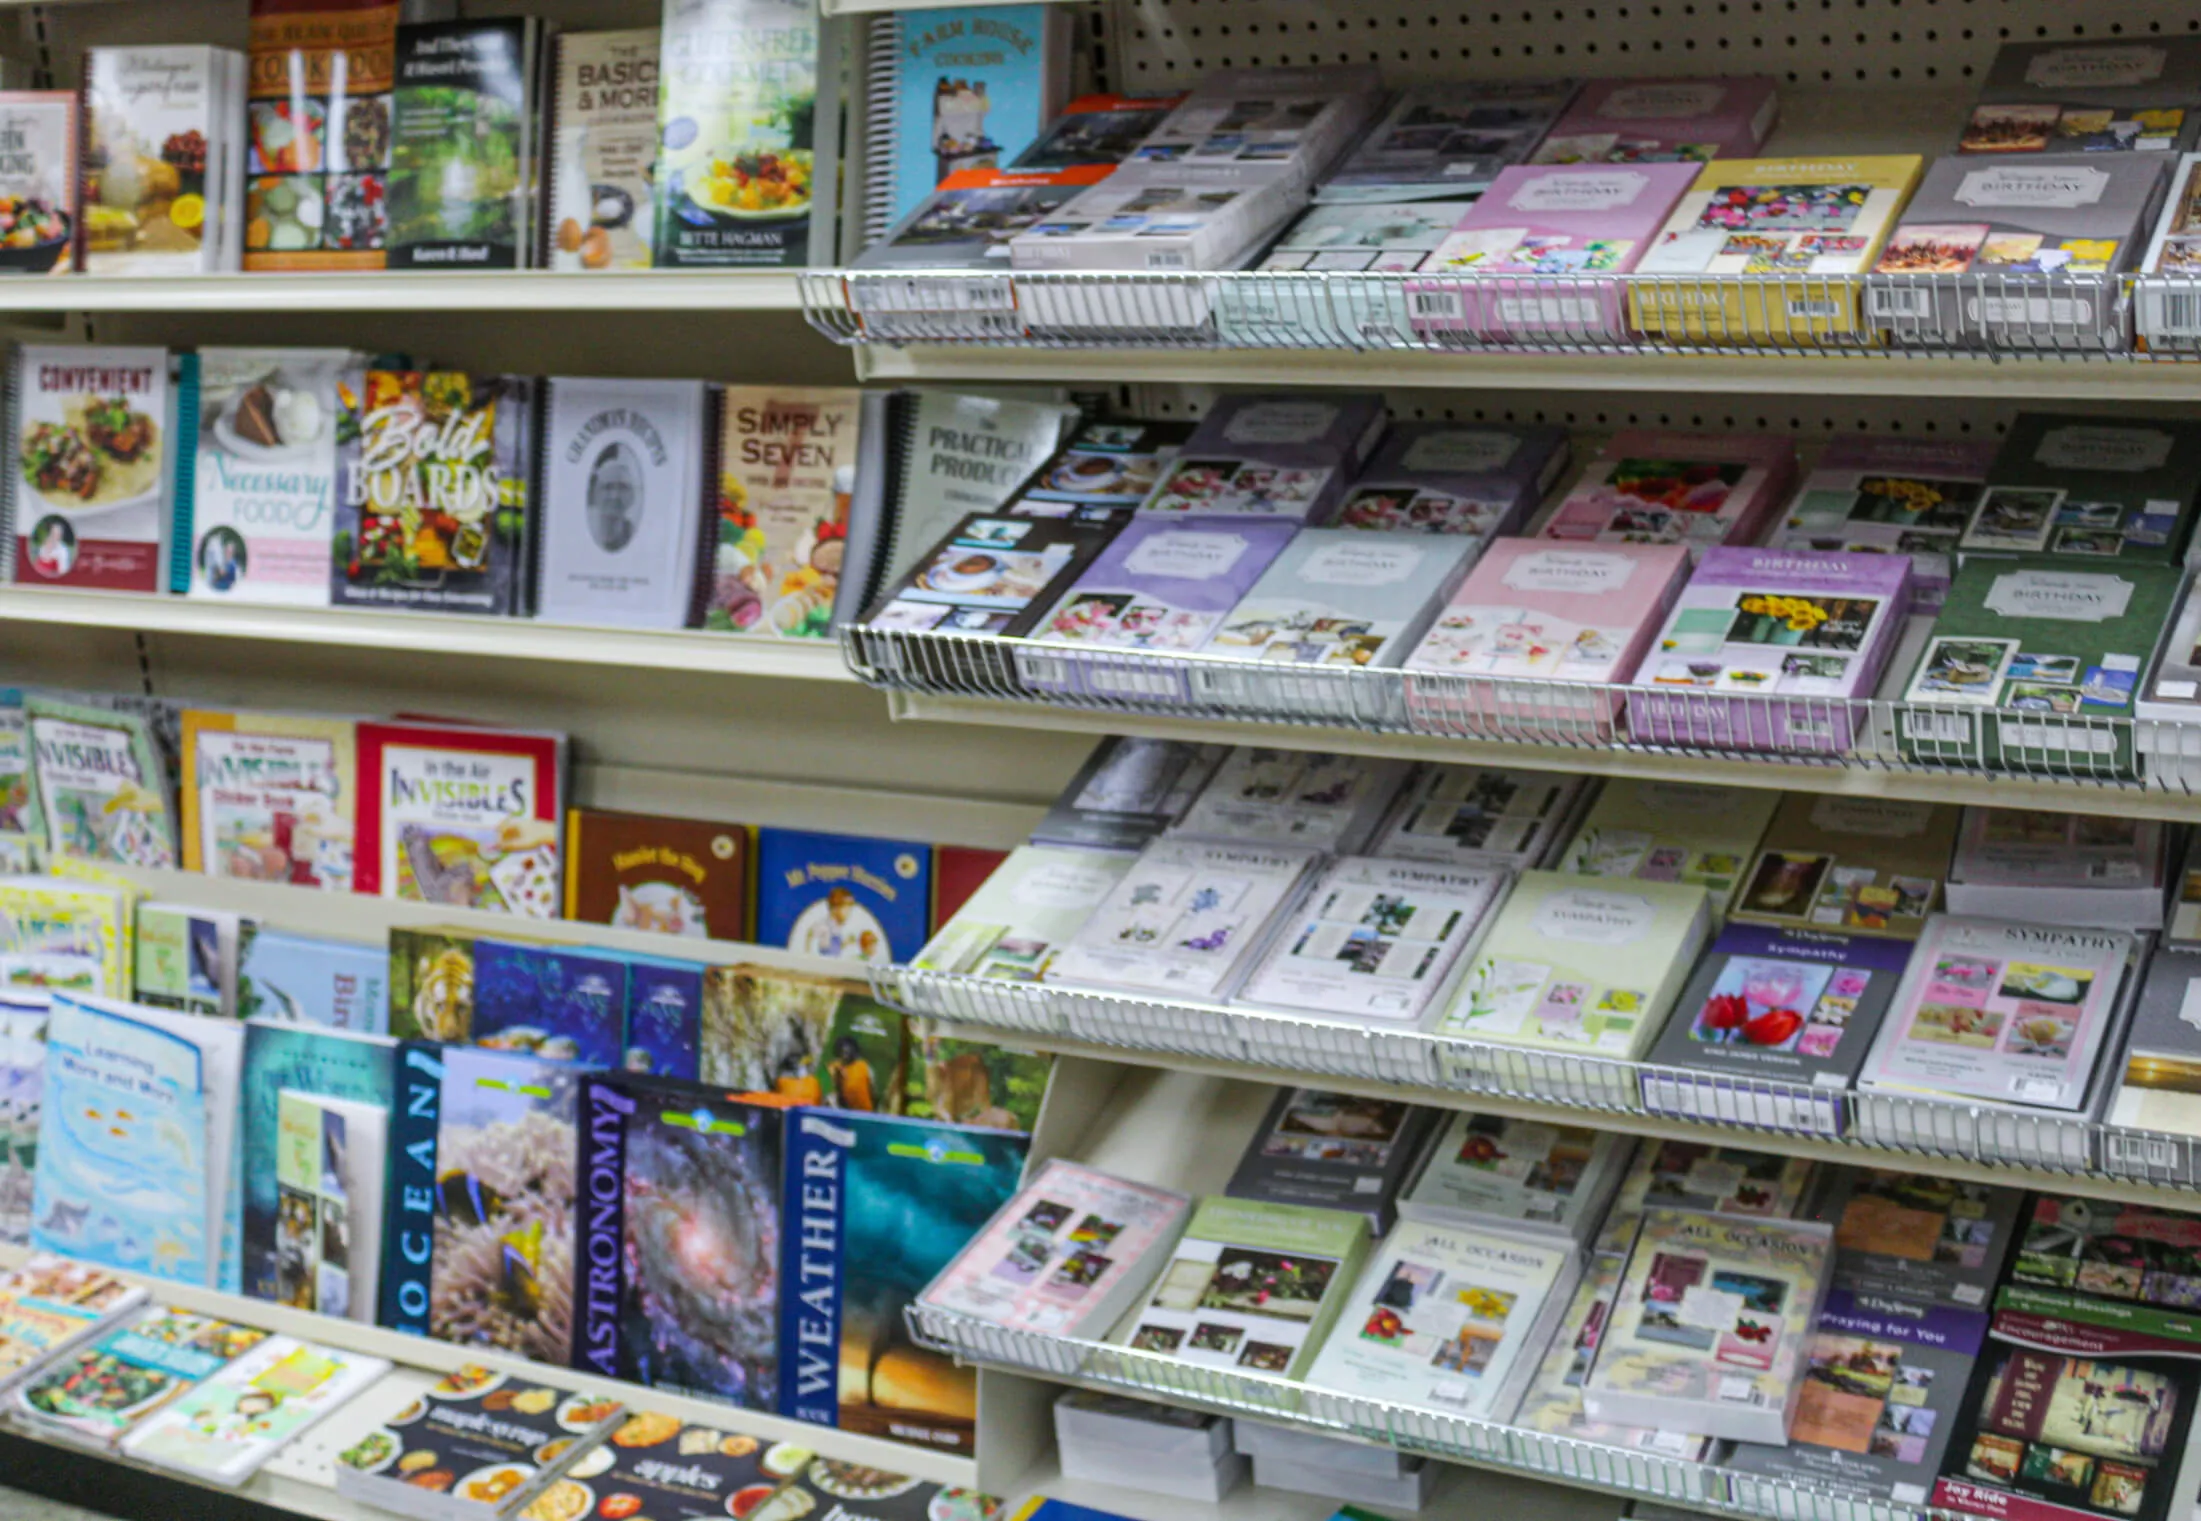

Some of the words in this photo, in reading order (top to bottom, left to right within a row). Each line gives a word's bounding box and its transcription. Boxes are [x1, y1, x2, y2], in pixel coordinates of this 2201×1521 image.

[1980, 178, 2086, 194] BIRTHDAY
[38, 364, 154, 395] CONVENIENT
[359, 403, 492, 472] Bold
[736, 406, 846, 439] SIMPLY
[740, 438, 835, 468] SEVEN
[345, 460, 500, 512] BOARDS
[929, 455, 1022, 487] PRODUC
[204, 451, 331, 531] Necessary
[233, 501, 294, 525] FOOD
[1752, 557, 1850, 573] BIRTHDAY
[2012, 588, 2106, 605] BIRTHDAY
[440, 760, 467, 778] the
[391, 767, 527, 818] INVISIBLES
[1386, 866, 1488, 890] SYMPATHY
[1767, 941, 1849, 962] Sympathy
[2003, 927, 2119, 952] SYMPATHY
[84, 1038, 156, 1077] Learning
[103, 1070, 136, 1091] and
[396, 1083, 438, 1318] OCEAN
[584, 1095, 622, 1377] ASTRONOMY
[1722, 1229, 1810, 1256] OCCASION
[1466, 1243, 1546, 1269] OCCASION
[796, 1147, 839, 1397] WEATHER
[1819, 1312, 1883, 1336] Praying
[1885, 1320, 1911, 1338] for
[1915, 1326, 1947, 1346] You
[1997, 1320, 2106, 1354] Encouragement
[1943, 1481, 1971, 1500] Joy
[1972, 1486, 2009, 1507] Ride
